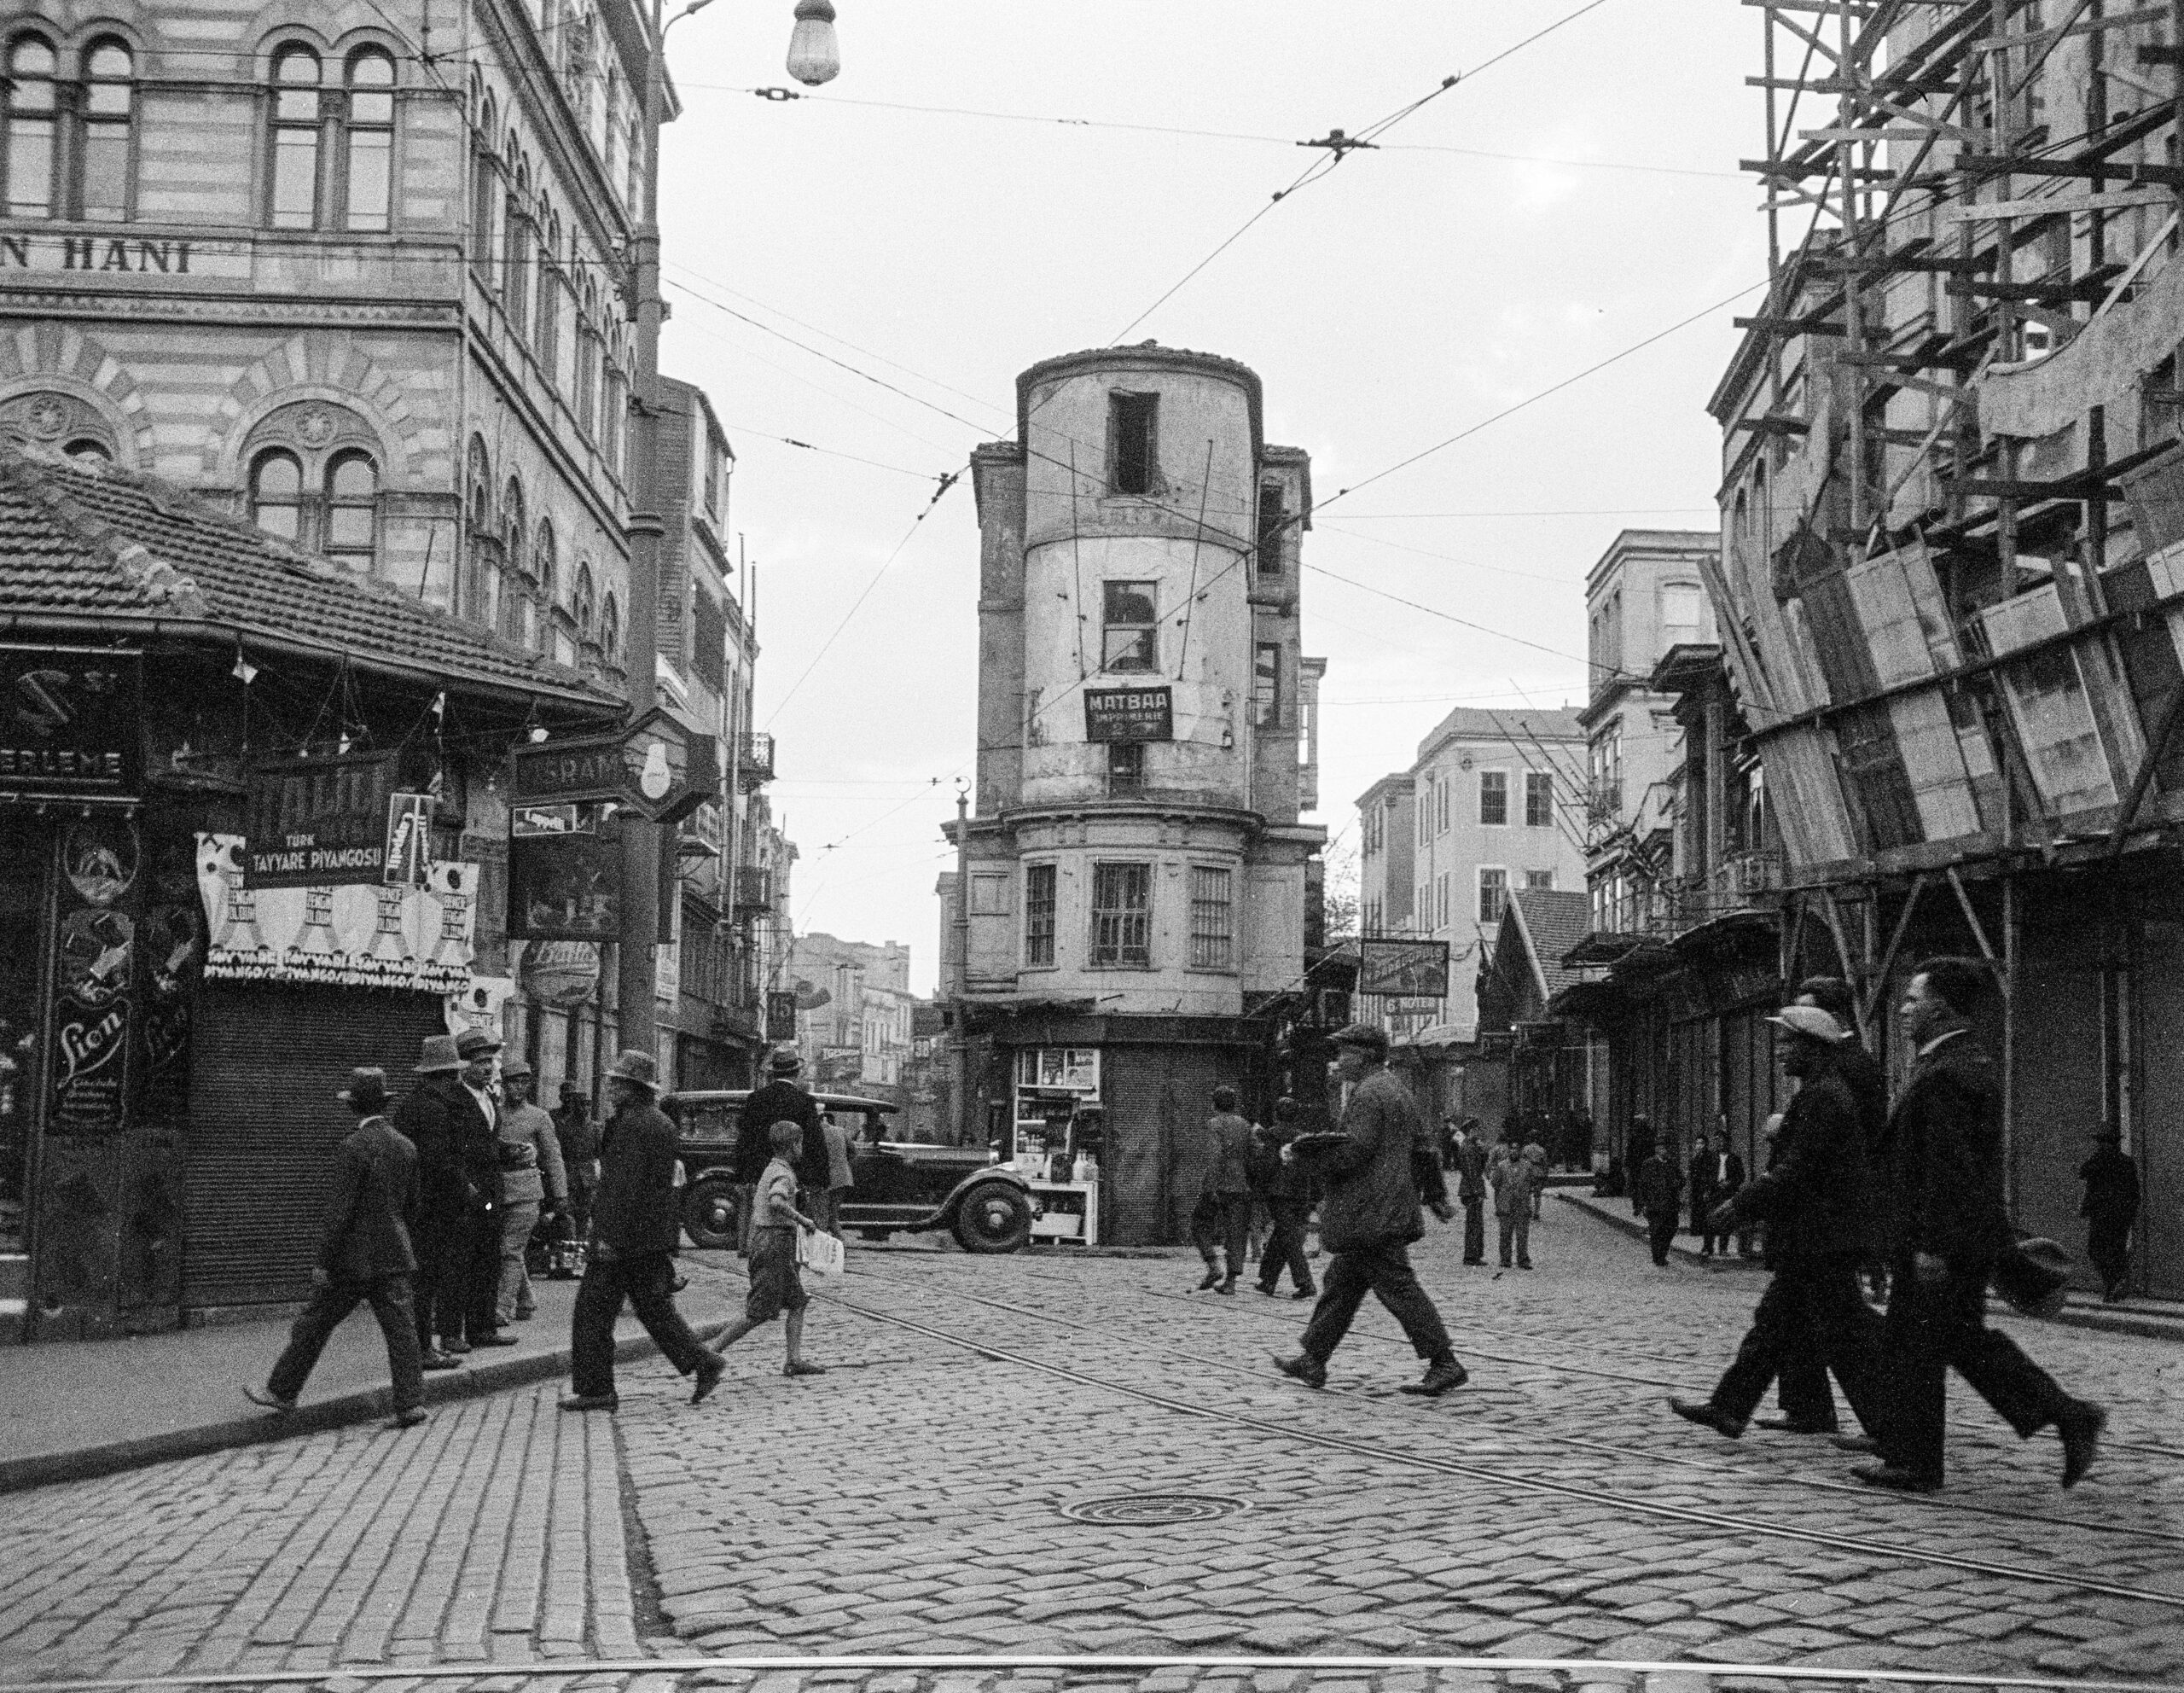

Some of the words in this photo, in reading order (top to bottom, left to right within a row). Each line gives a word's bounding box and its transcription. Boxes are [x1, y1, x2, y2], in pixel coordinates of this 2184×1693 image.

[62, 236, 193, 274] HANI
[1089, 693, 1168, 710] MATBAA
[253, 852, 306, 872] TAYYARE
[56, 1011, 125, 1090] Lion
